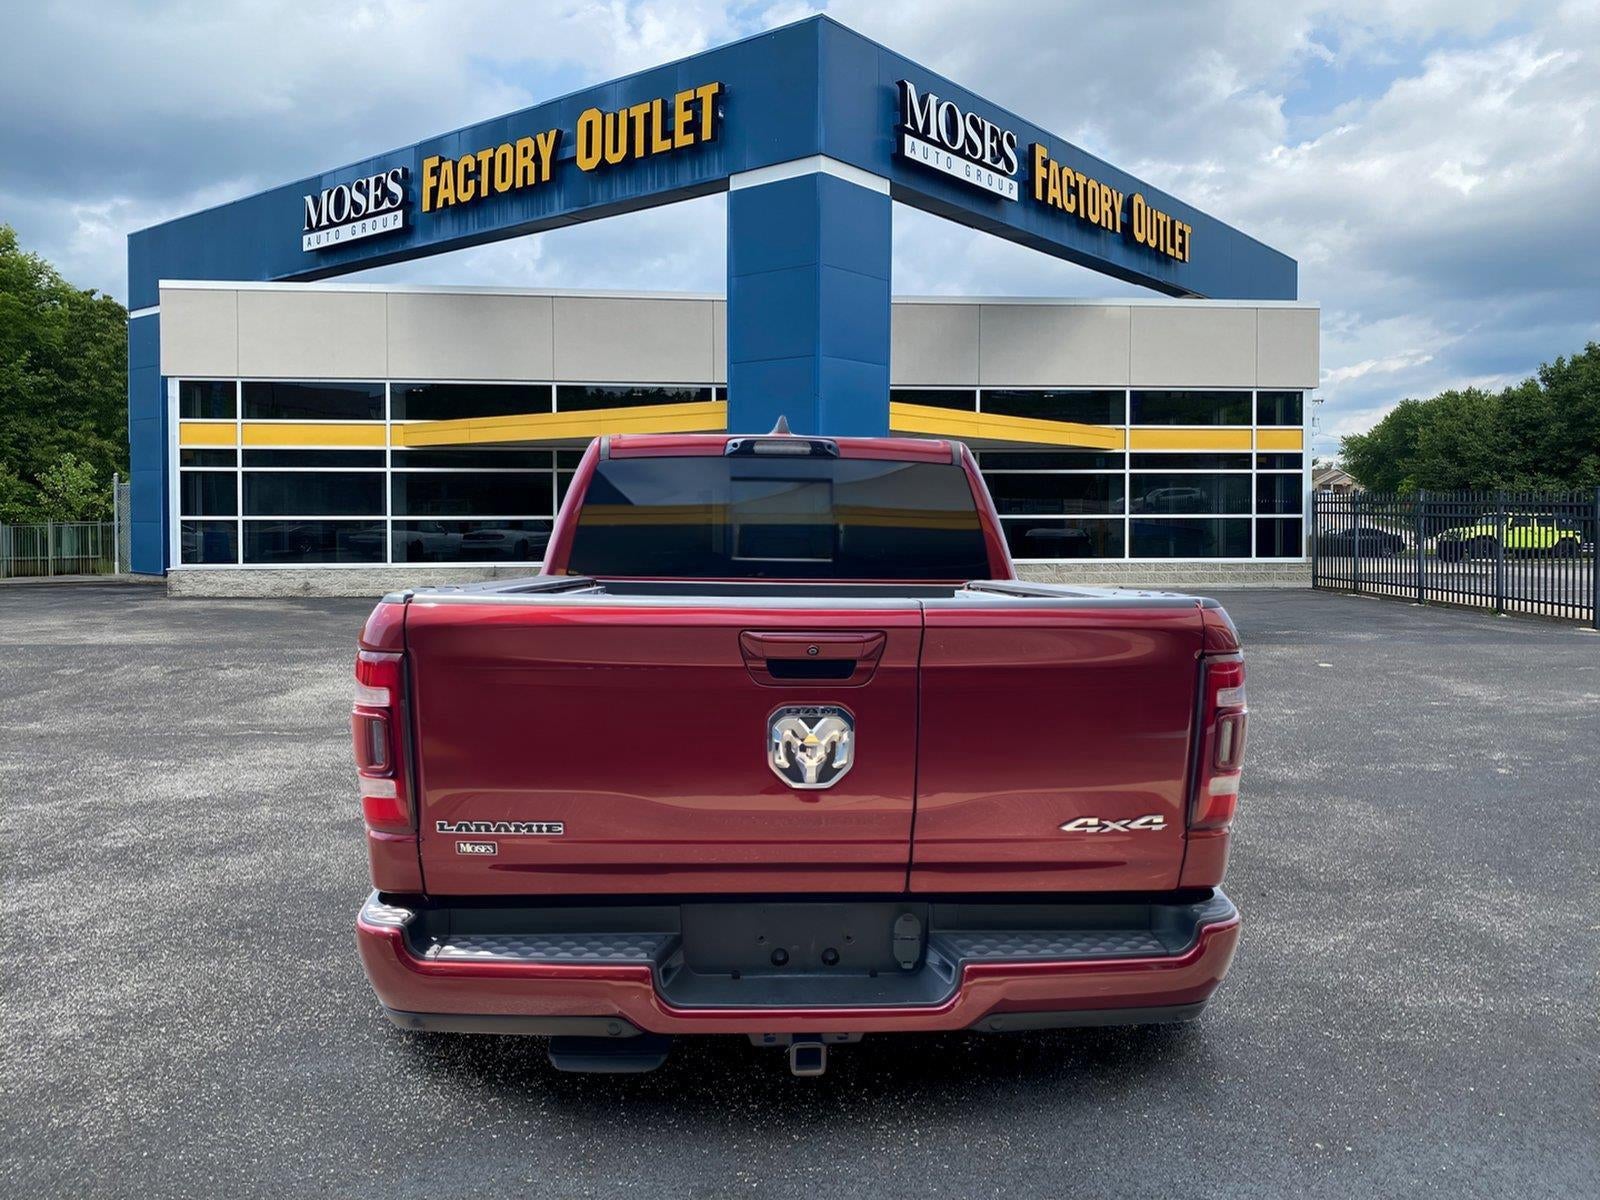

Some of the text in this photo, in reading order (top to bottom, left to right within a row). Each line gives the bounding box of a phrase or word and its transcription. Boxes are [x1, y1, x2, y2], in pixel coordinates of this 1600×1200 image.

[421, 81, 720, 213] FACTORY OUTLET
[903, 80, 1019, 176] MOSES
[302, 166, 404, 231] MOSES
[909, 140, 1015, 196] AUTO GROUP
[306, 213, 400, 248] AUTO GROUP
[1034, 142, 1192, 263] FACTORY OUTLET
[436, 820, 564, 835] LARAMIE
